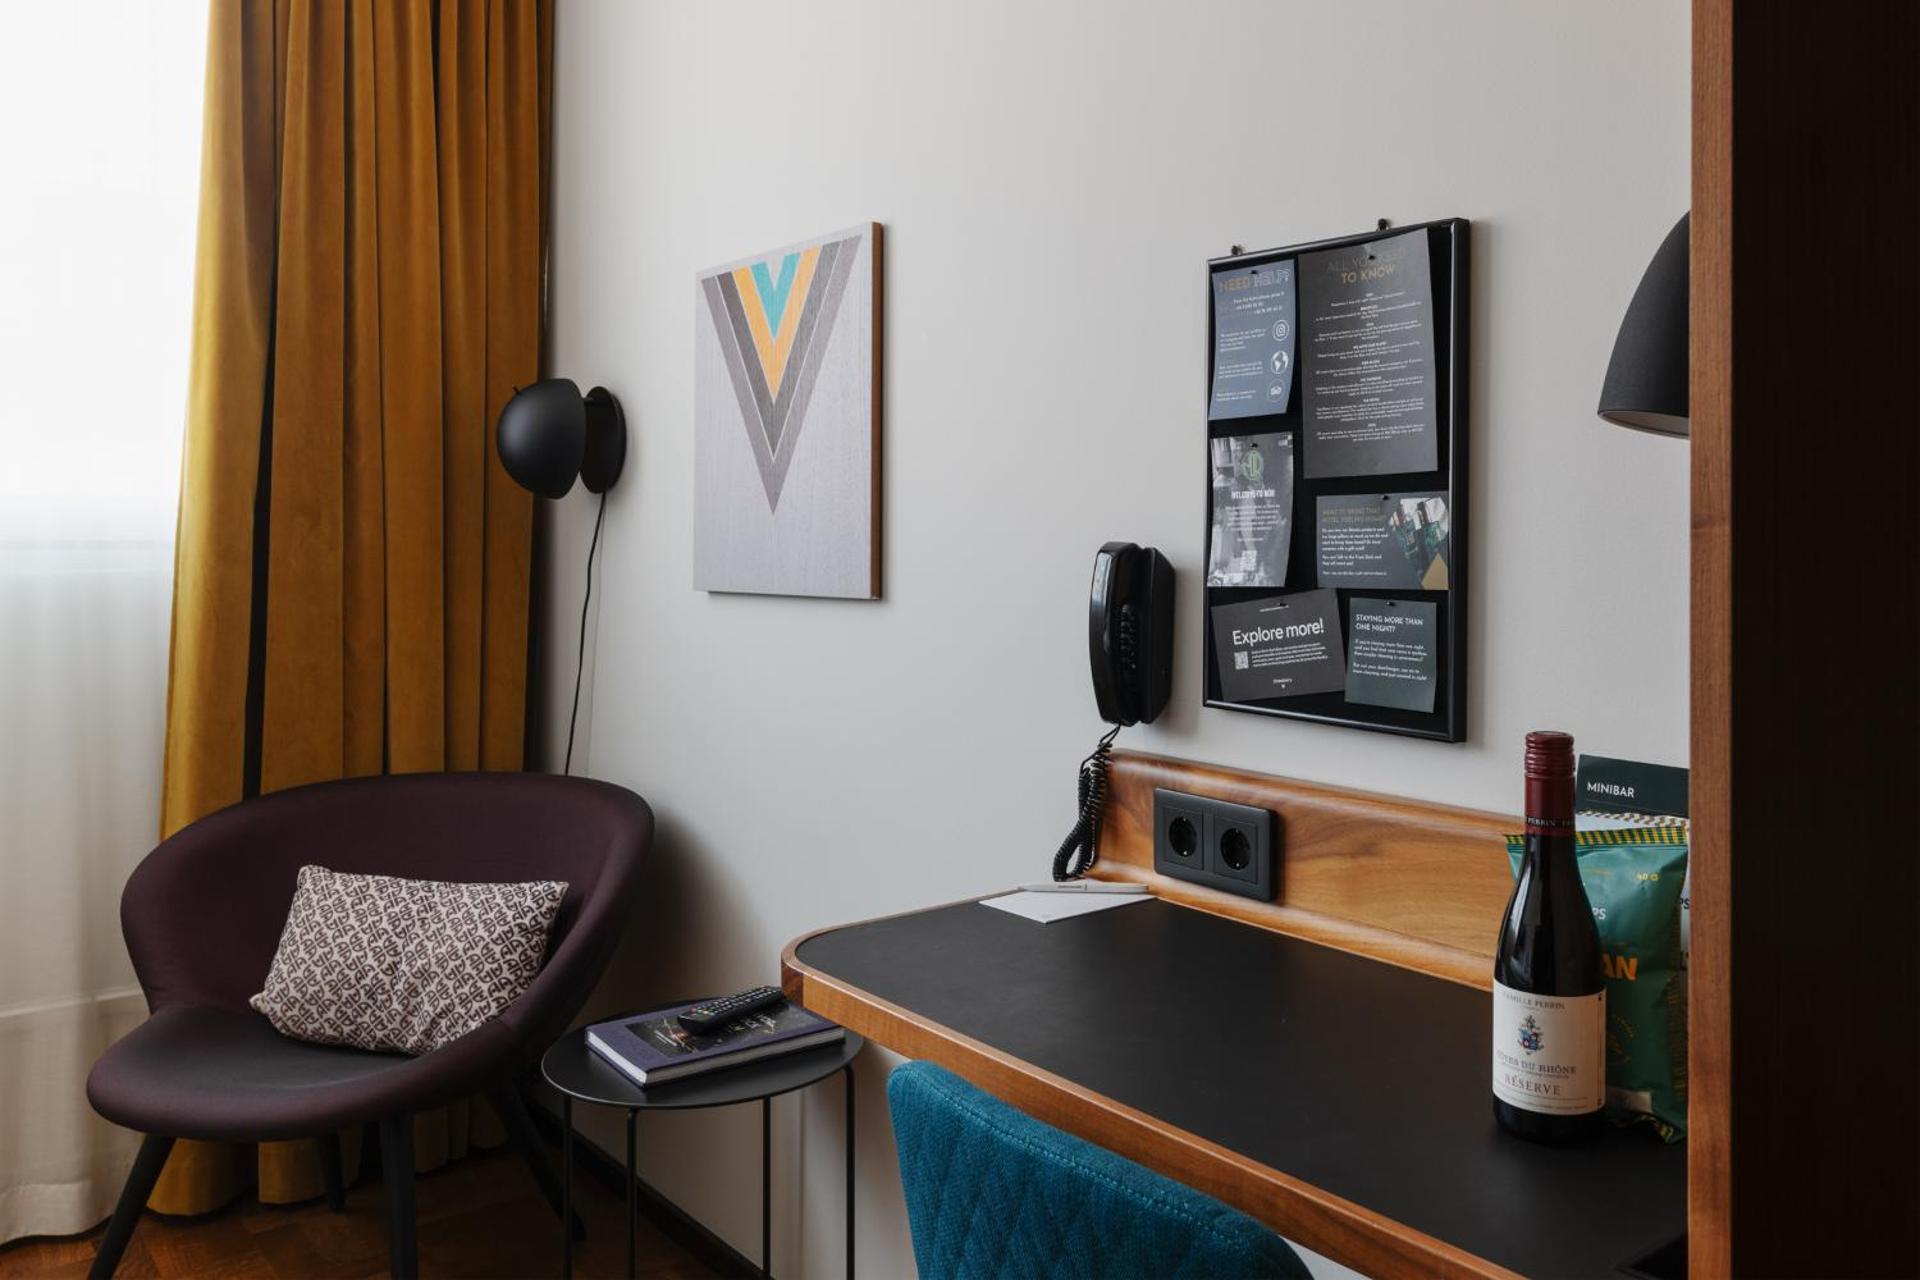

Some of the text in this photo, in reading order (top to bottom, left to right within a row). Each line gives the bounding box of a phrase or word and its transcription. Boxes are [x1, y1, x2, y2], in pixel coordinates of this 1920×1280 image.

[1341, 263, 1395, 284] TO KNOW
[1218, 276, 1249, 291] NEED
[1355, 622, 1396, 632] ONE NIGHT?
[1356, 614, 1423, 625] STAYING MORE THAN
[1232, 617, 1324, 647] Explore more!
[1586, 781, 1635, 798] MINIBAR
[1535, 1000, 1565, 1009] PERRIN
[1521, 1060, 1536, 1070] DU
[1538, 1063, 1577, 1074] RHÔNE
[1504, 1073, 1561, 1096] RÉSERVE
